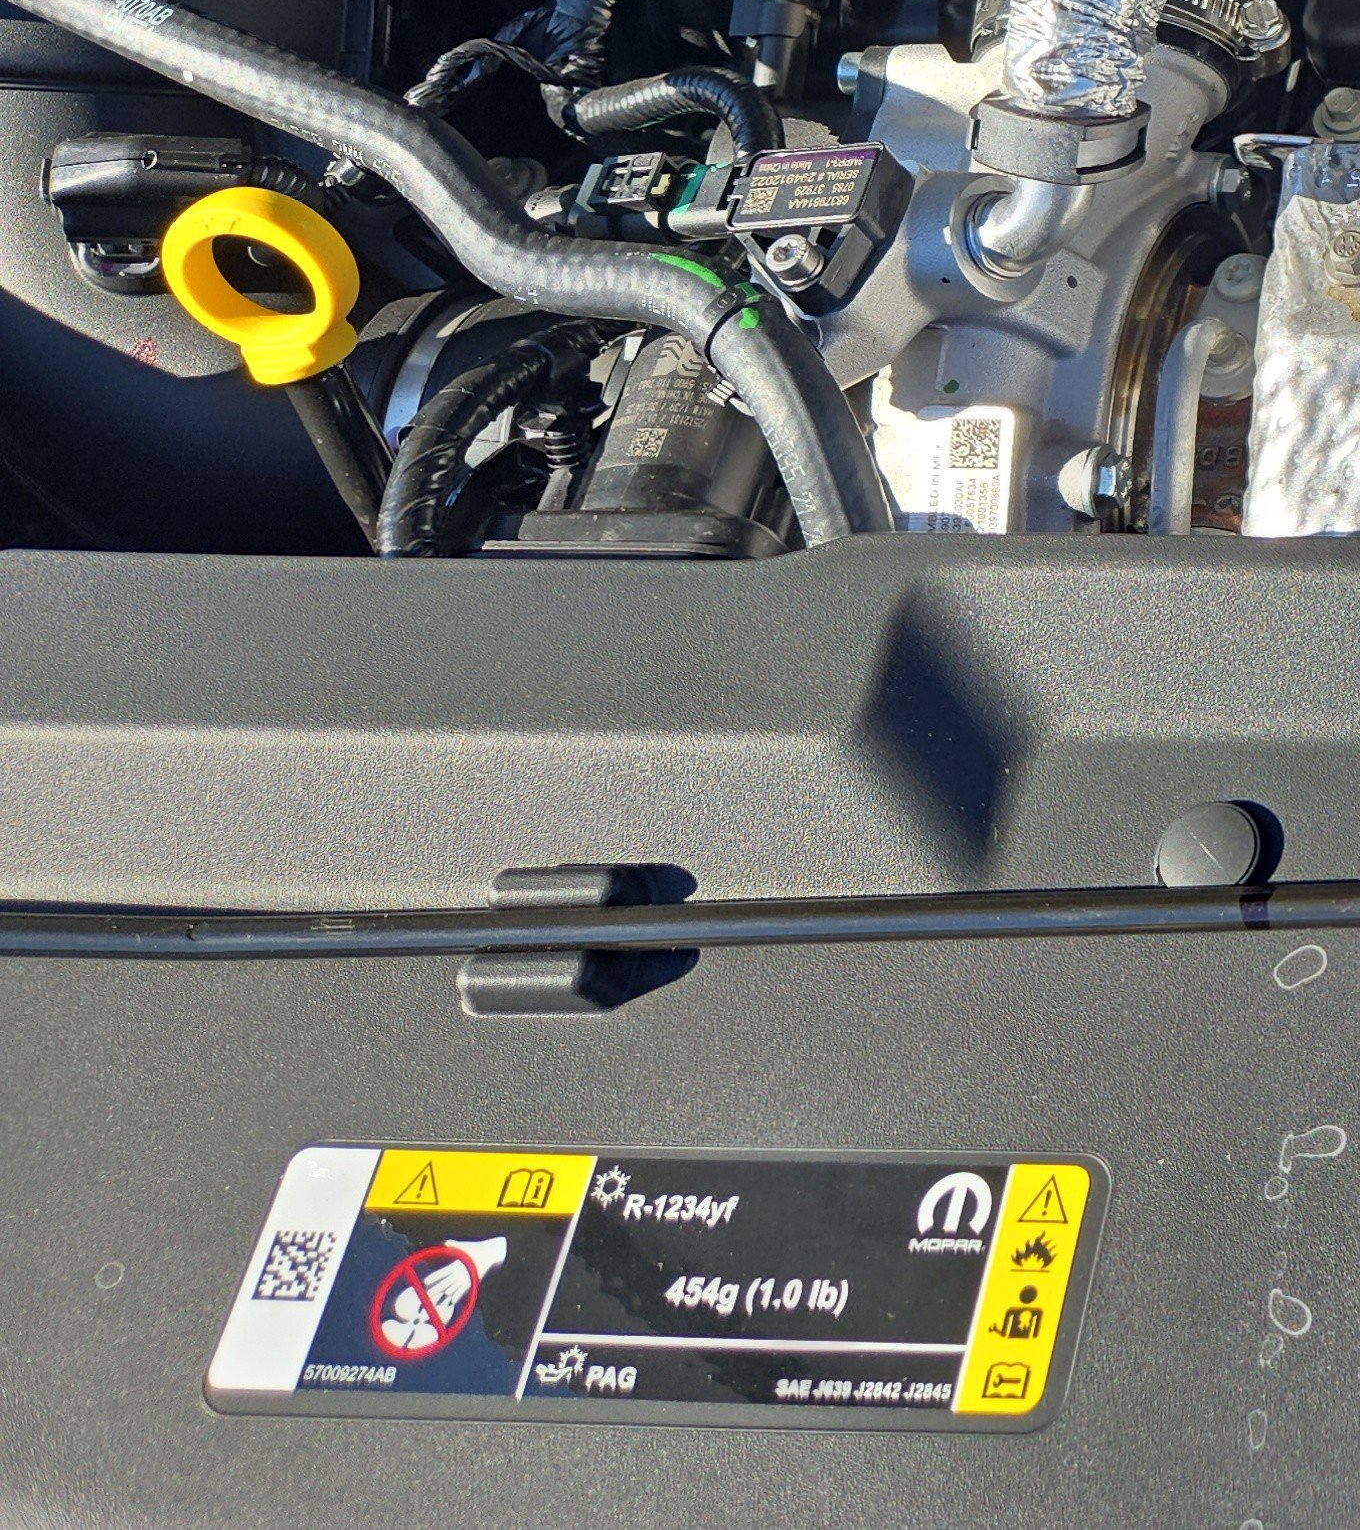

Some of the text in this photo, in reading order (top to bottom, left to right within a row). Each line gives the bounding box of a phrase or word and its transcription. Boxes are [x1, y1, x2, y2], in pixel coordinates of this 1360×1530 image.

[827, 170, 860, 181] SERIAL
[623, 1194, 739, 1228] R-1234yf
[664, 1276, 849, 1319] 454g (1.0 lb)
[302, 1365, 398, 1384] 57009274AB
[585, 1366, 638, 1391] PAG
[775, 1379, 813, 1399] SAE
[853, 1380, 902, 1400] J2842
[902, 1382, 953, 1401] J2845
